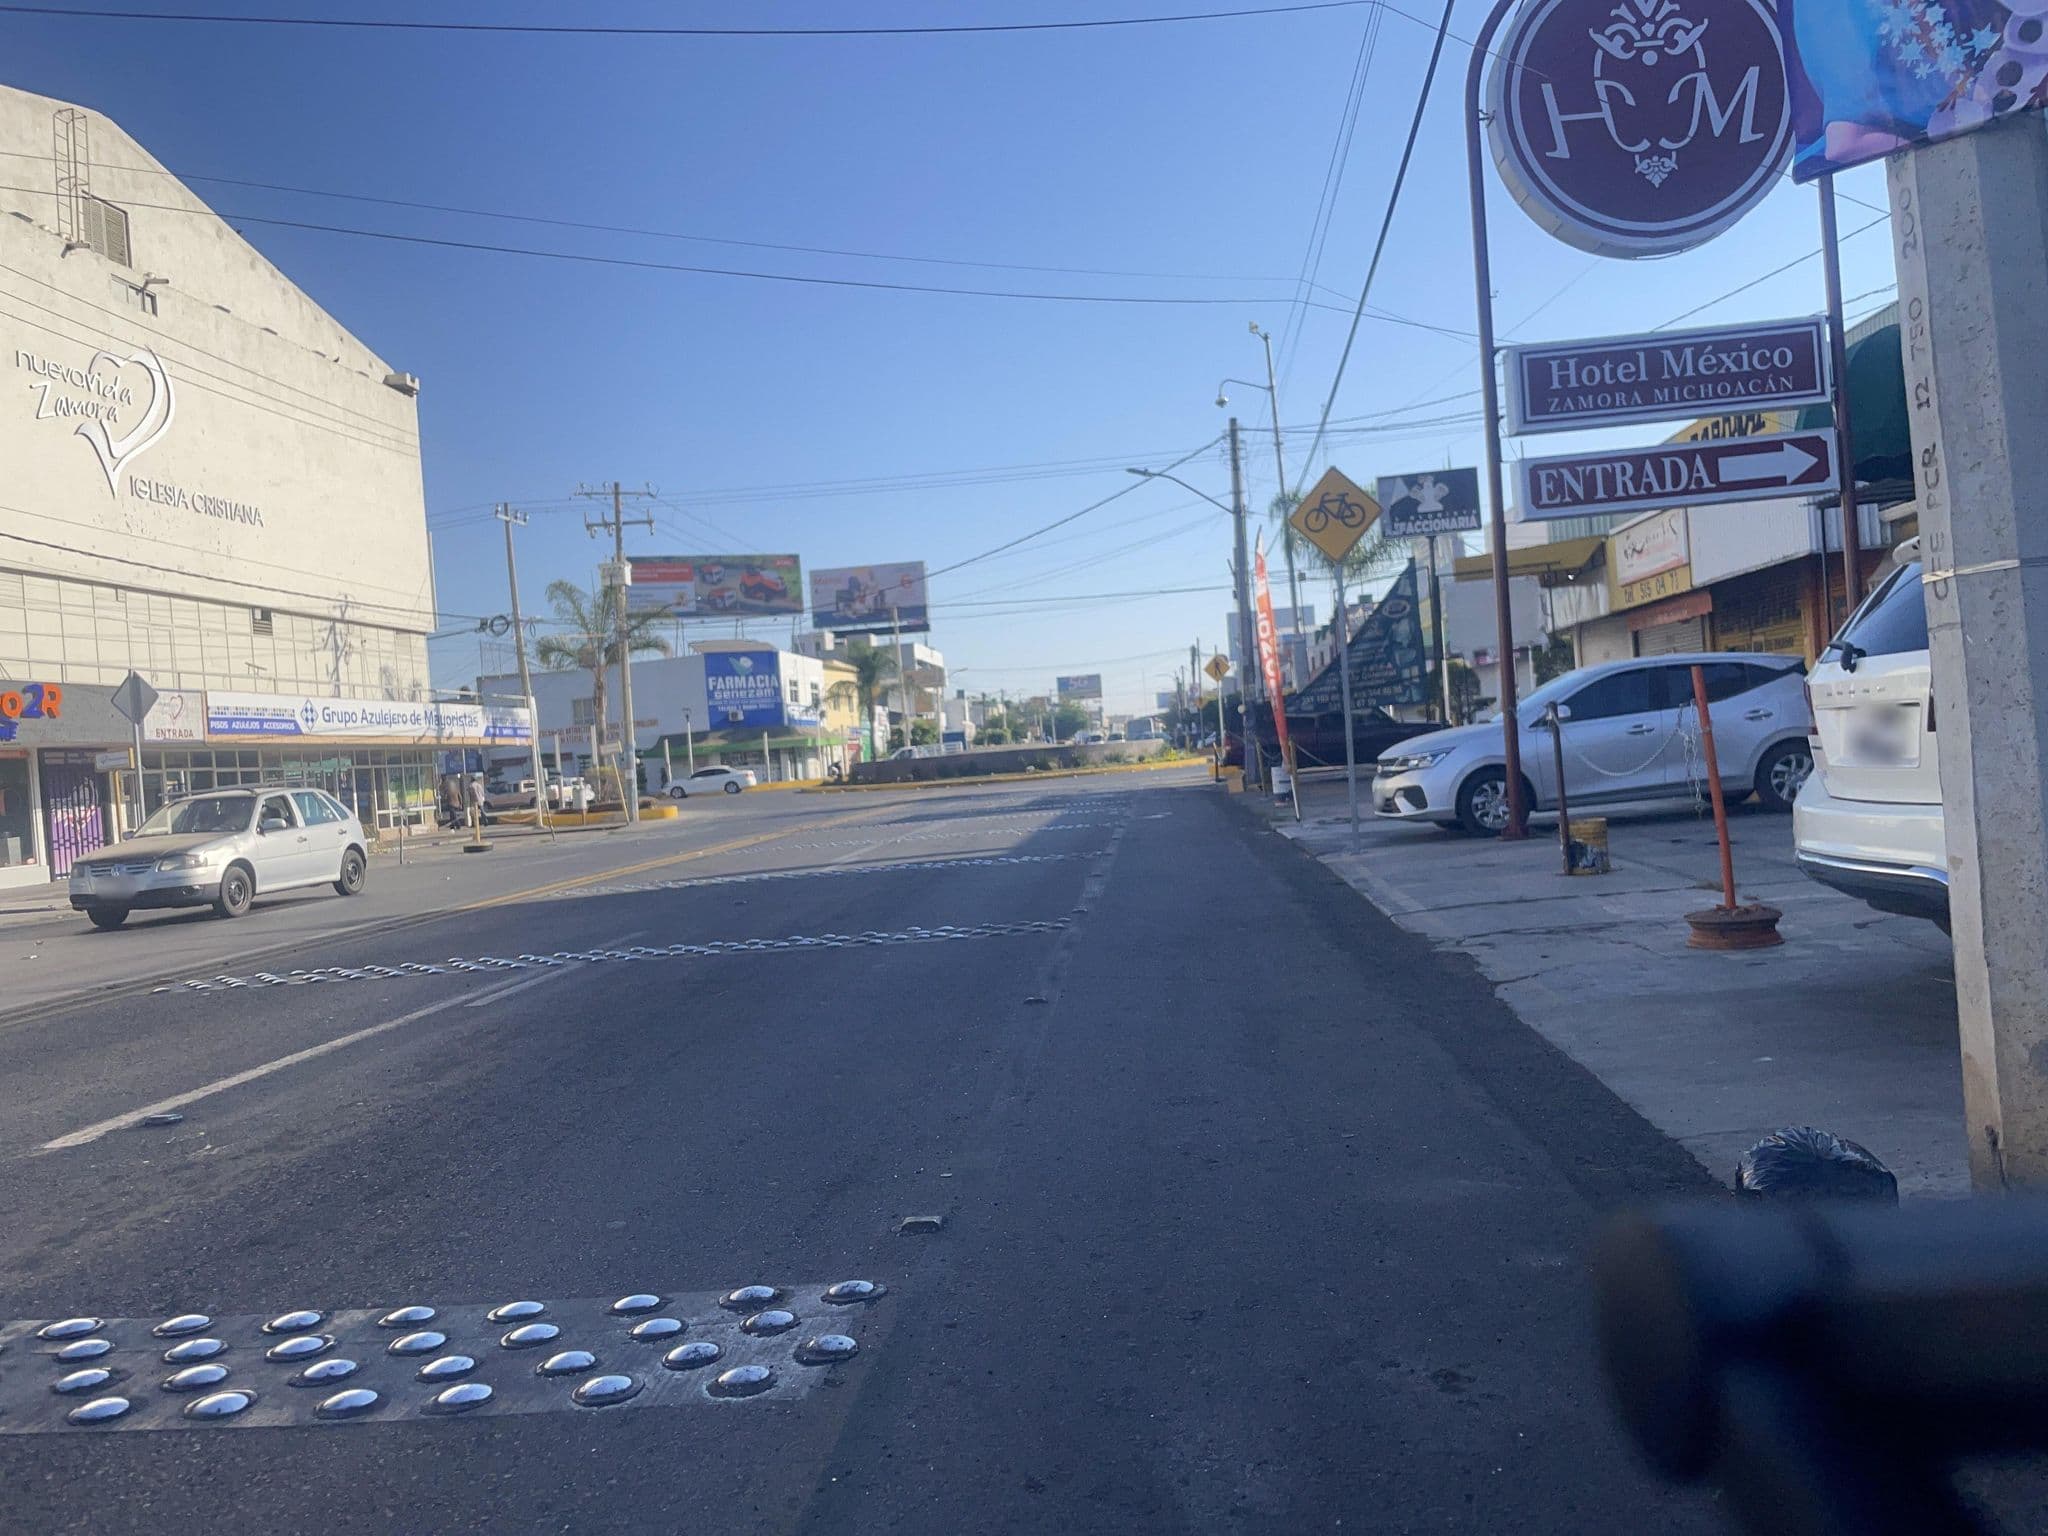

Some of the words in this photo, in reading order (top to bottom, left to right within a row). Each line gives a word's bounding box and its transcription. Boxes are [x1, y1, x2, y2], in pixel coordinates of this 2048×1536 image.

[1549, 351, 1648, 390] Hotel
[1661, 343, 1793, 380] México
[29, 381, 118, 424] Zamora
[1547, 391, 1642, 413] ZAMORA
[1654, 374, 1793, 404] MICHOACÁN
[1537, 453, 1717, 505] ENTRADA
[1921, 441, 1940, 510] PCR
[129, 475, 189, 510] IGLESIA
[191, 491, 264, 527] CRISTIANA
[707, 675, 779, 690] FARMACIA
[155, 727, 195, 739] ENTRADA
[210, 720, 229, 730] PISOS
[231, 721, 260, 730] AZULEJOS
[322, 706, 358, 727] Grupo
[360, 708, 408, 728] Azulejero
[410, 711, 422, 725] de
[424, 710, 479, 729] Mayoristas
